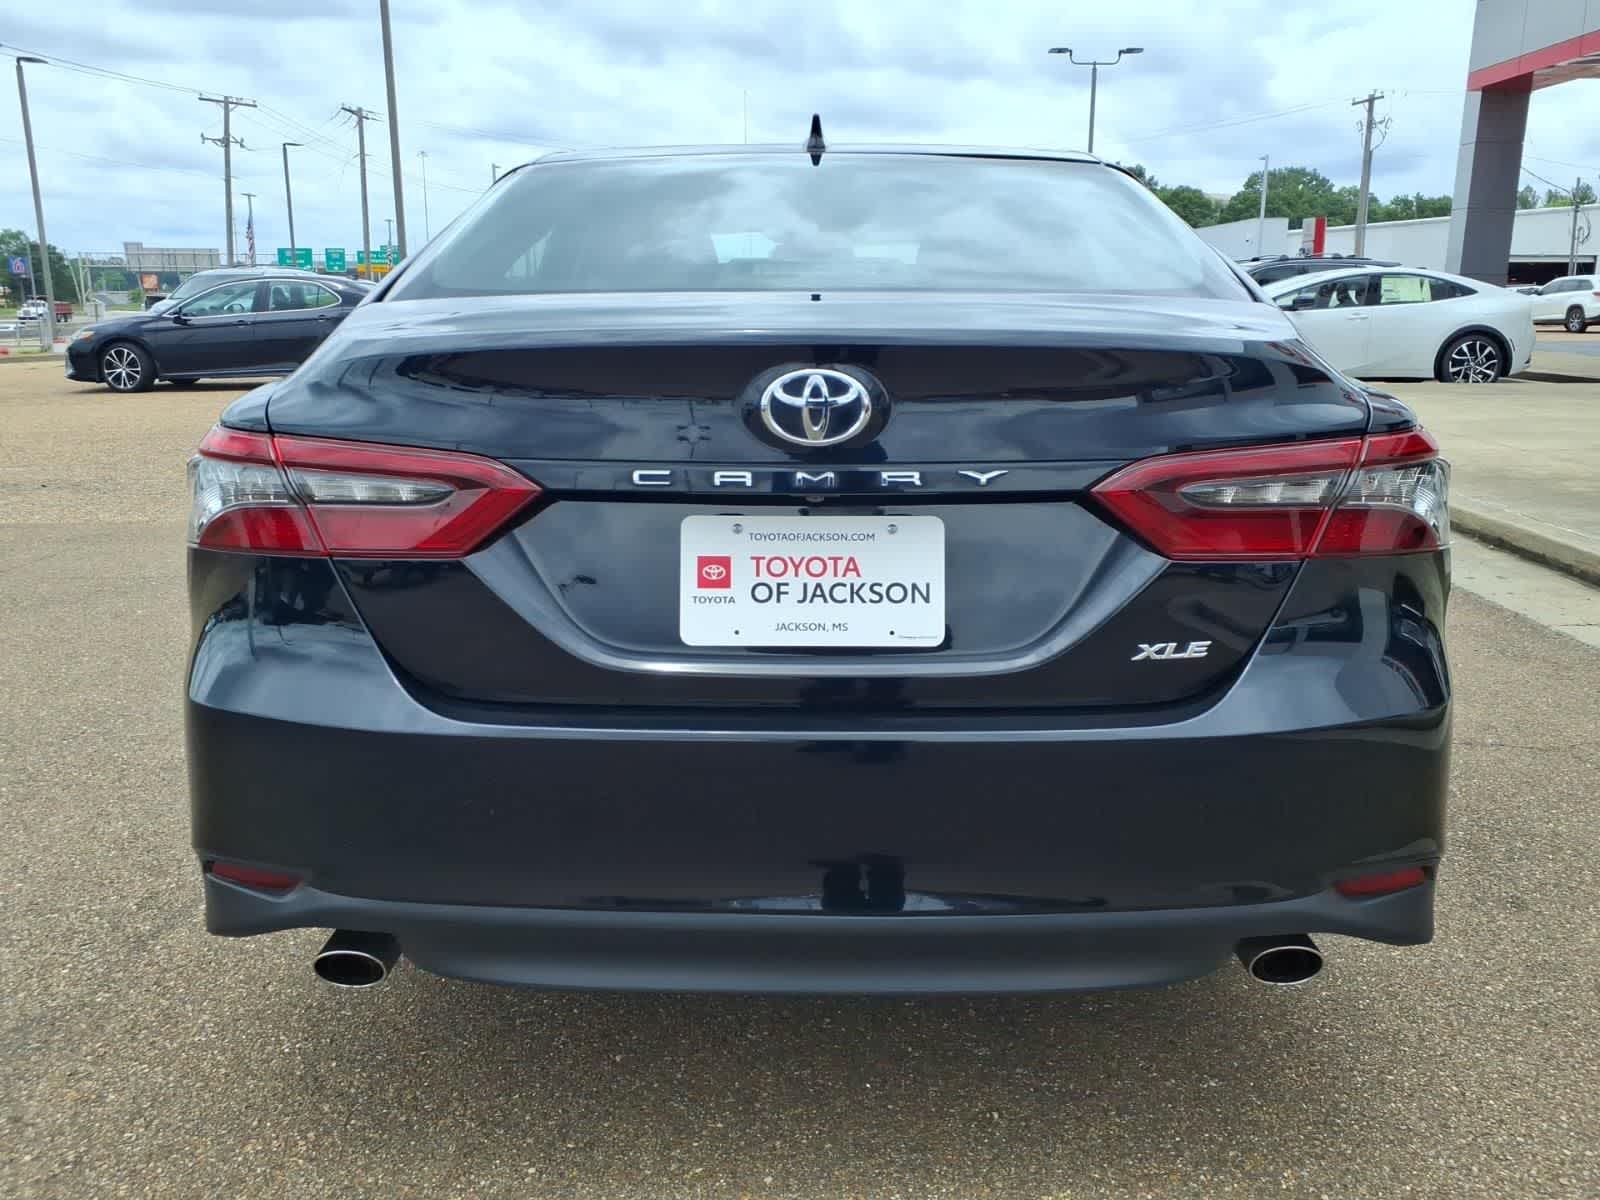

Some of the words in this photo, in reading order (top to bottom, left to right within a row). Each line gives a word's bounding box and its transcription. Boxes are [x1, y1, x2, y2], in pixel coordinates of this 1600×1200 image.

[633, 470, 1009, 486] CAMRY
[750, 533, 875, 542] TOYOTAOFJACKSON.COM
[750, 556, 862, 578] TOYOTA
[692, 595, 736, 604] TOYOTA
[751, 582, 789, 604] OF
[797, 582, 930, 604] JACKSON
[775, 622, 829, 633] JACKSON,
[832, 622, 848, 632] MS
[1130, 641, 1212, 661] XLE
